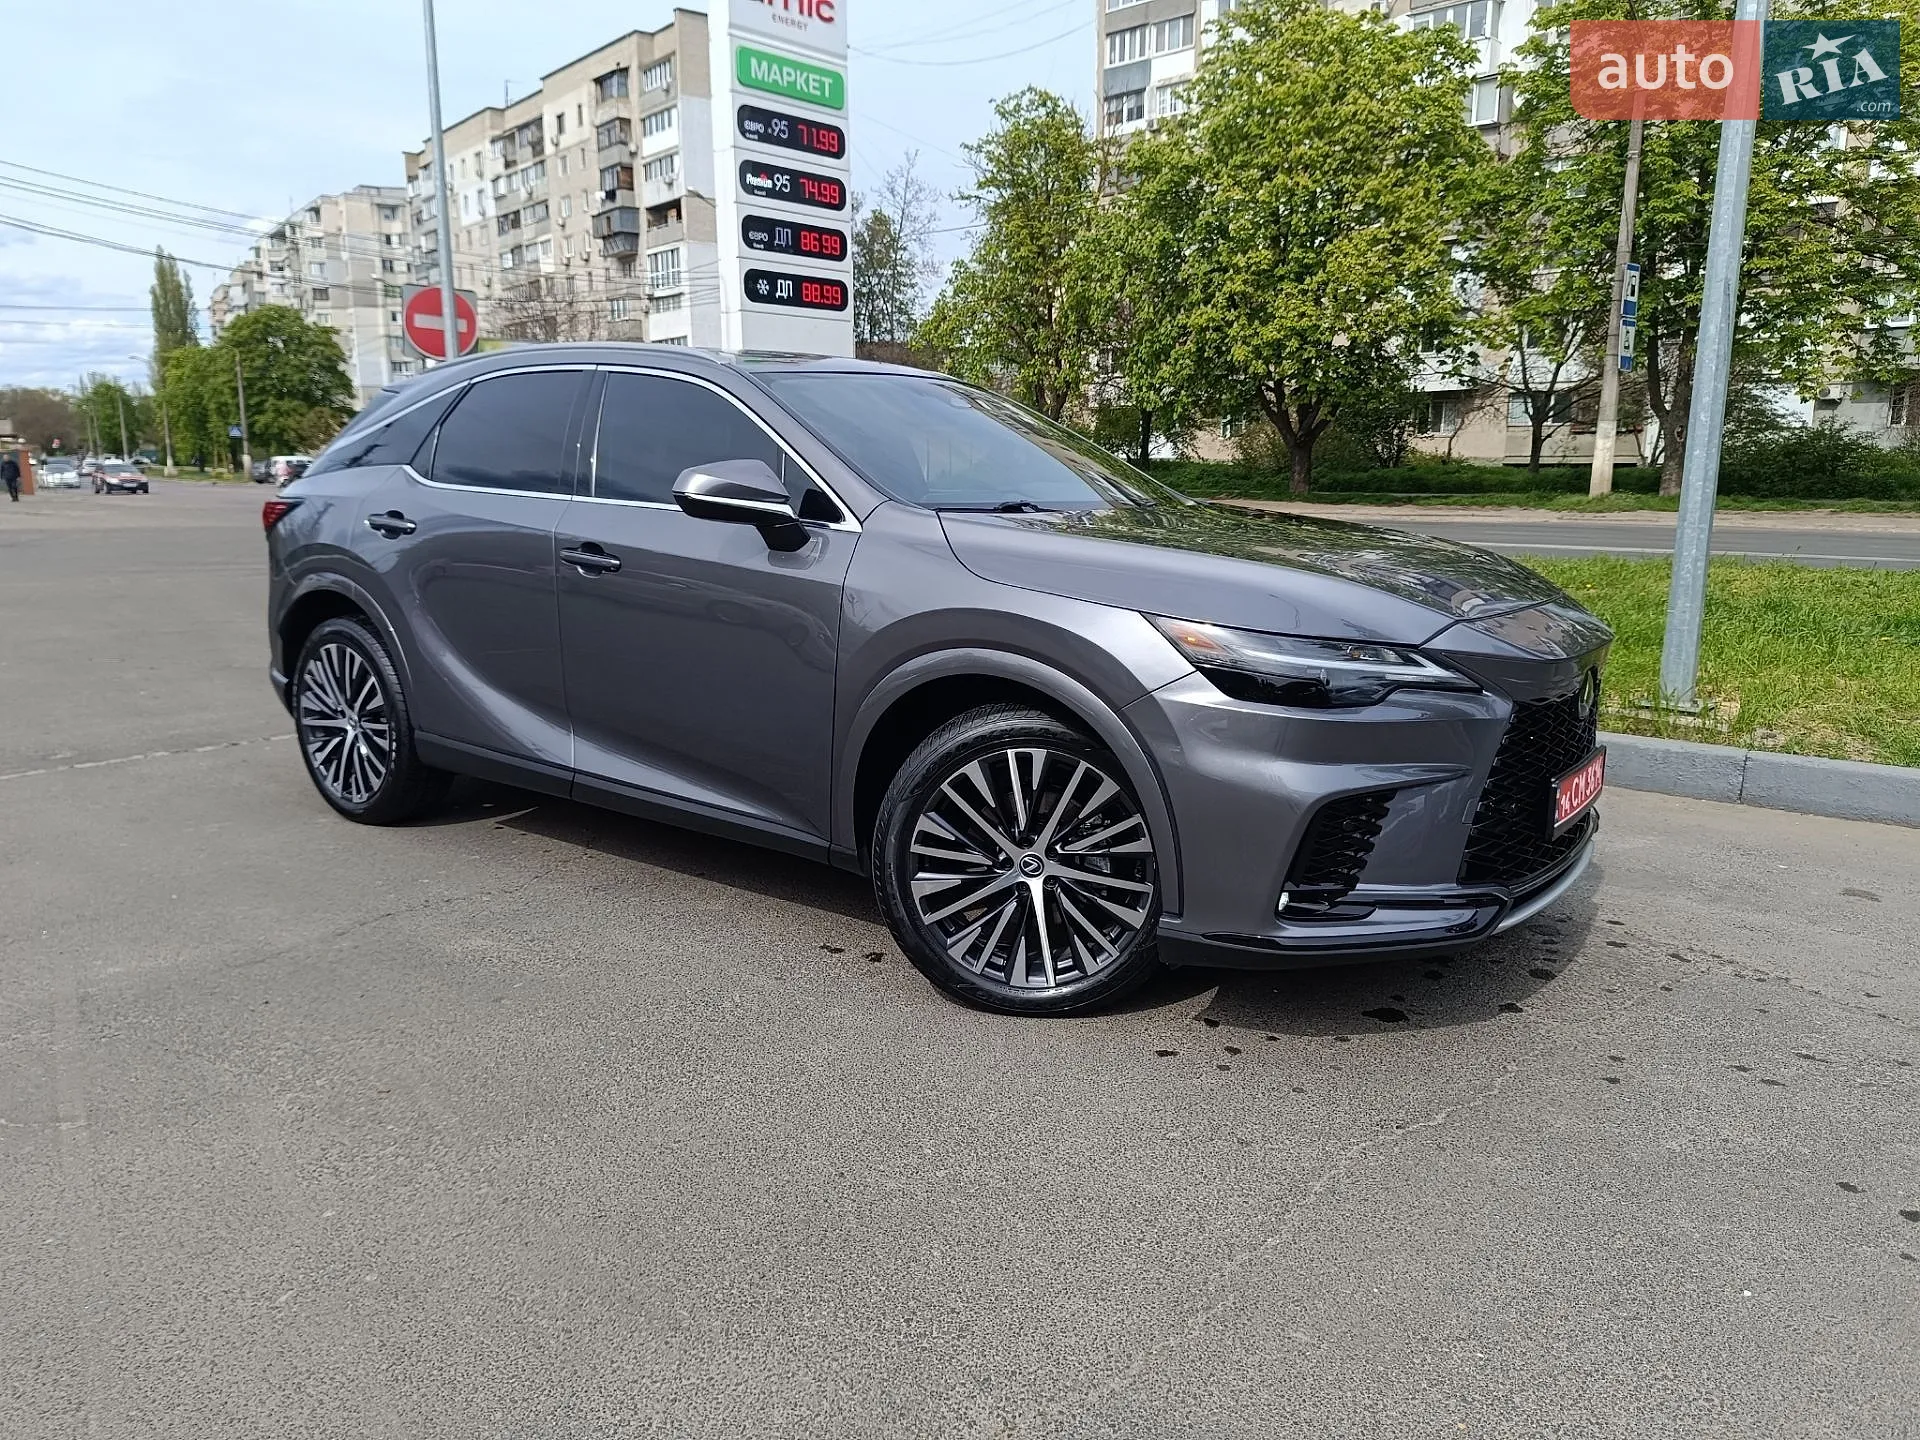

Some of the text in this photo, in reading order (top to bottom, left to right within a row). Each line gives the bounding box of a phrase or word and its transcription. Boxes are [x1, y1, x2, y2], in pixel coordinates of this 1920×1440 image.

[750, 56, 833, 98] МАРКЕТ
[771, 118, 789, 139] 95
[797, 124, 839, 153] 71.99
[773, 173, 791, 193] 95
[799, 178, 840, 205] 74.99
[774, 226, 792, 248] ДП
[775, 278, 841, 305] ДП 88.99
